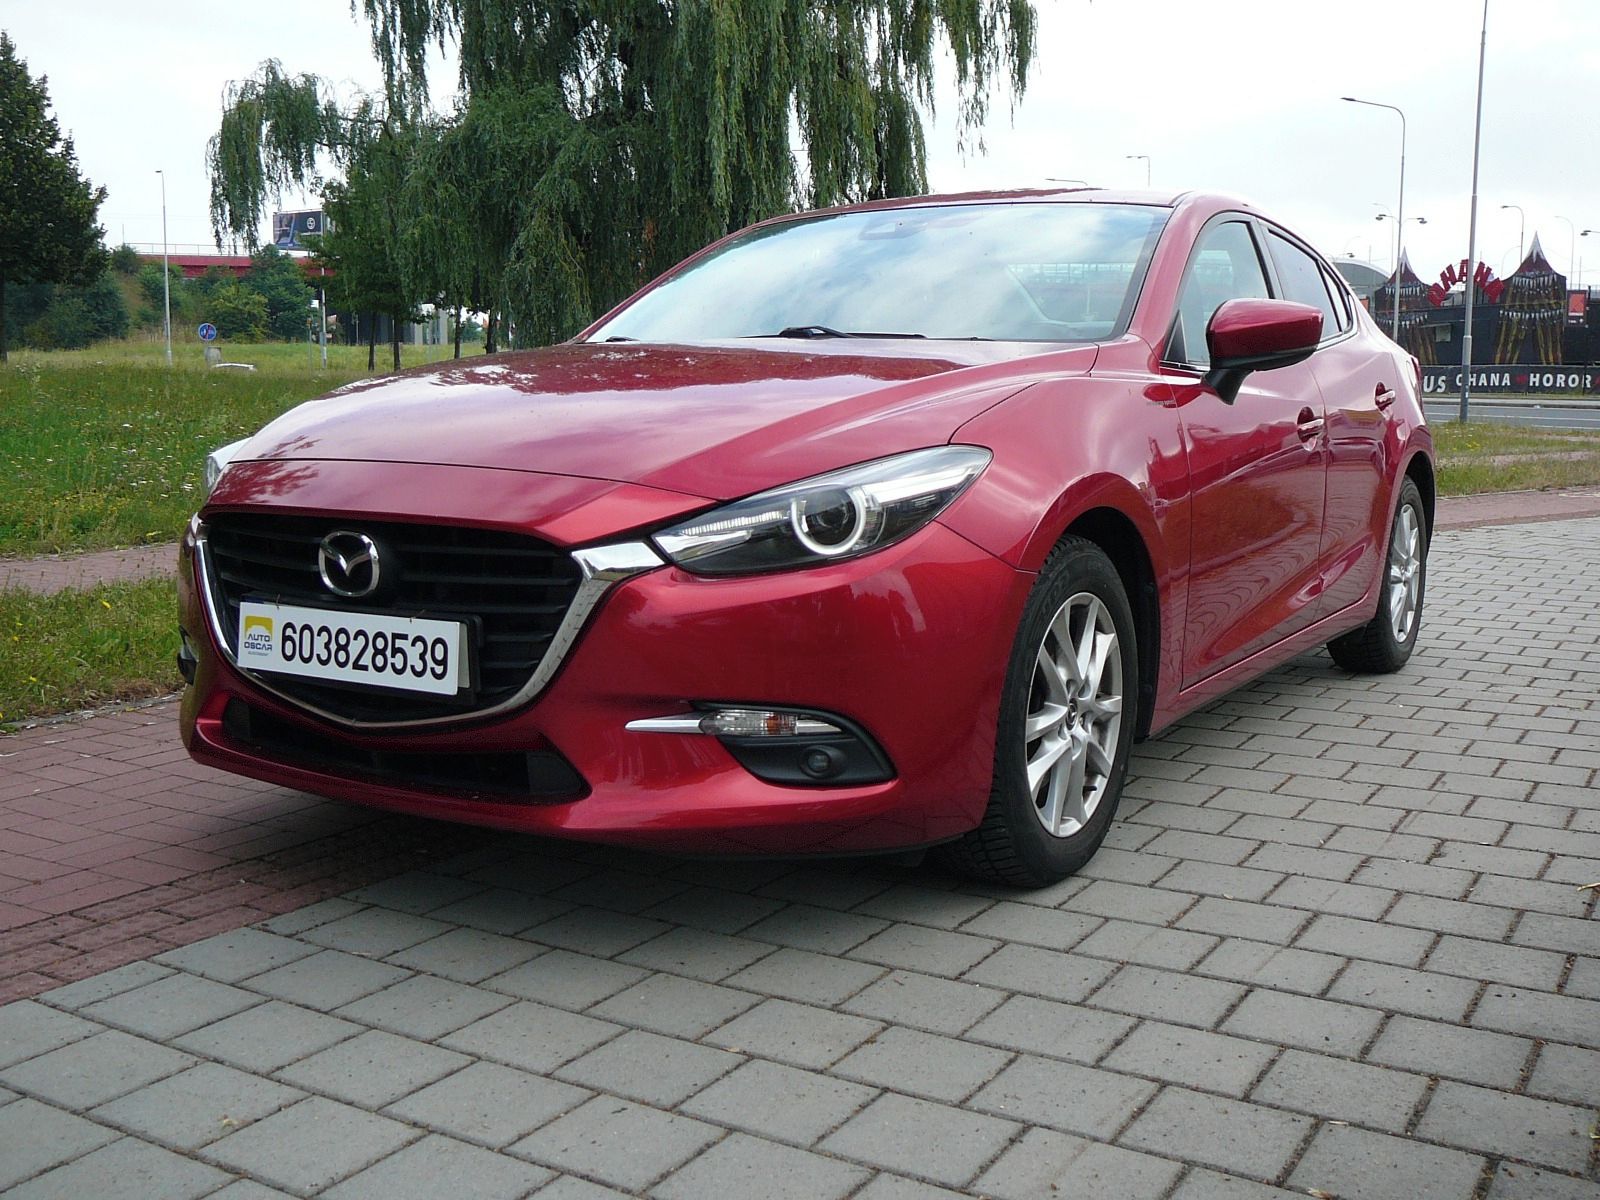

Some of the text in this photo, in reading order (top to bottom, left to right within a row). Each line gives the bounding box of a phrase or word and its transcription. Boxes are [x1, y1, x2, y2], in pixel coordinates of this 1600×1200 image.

[1529, 373, 1592, 388] HOROR
[248, 633, 271, 643] AUTO
[244, 641, 273, 652] OSCAR
[281, 621, 449, 681] 603828539
